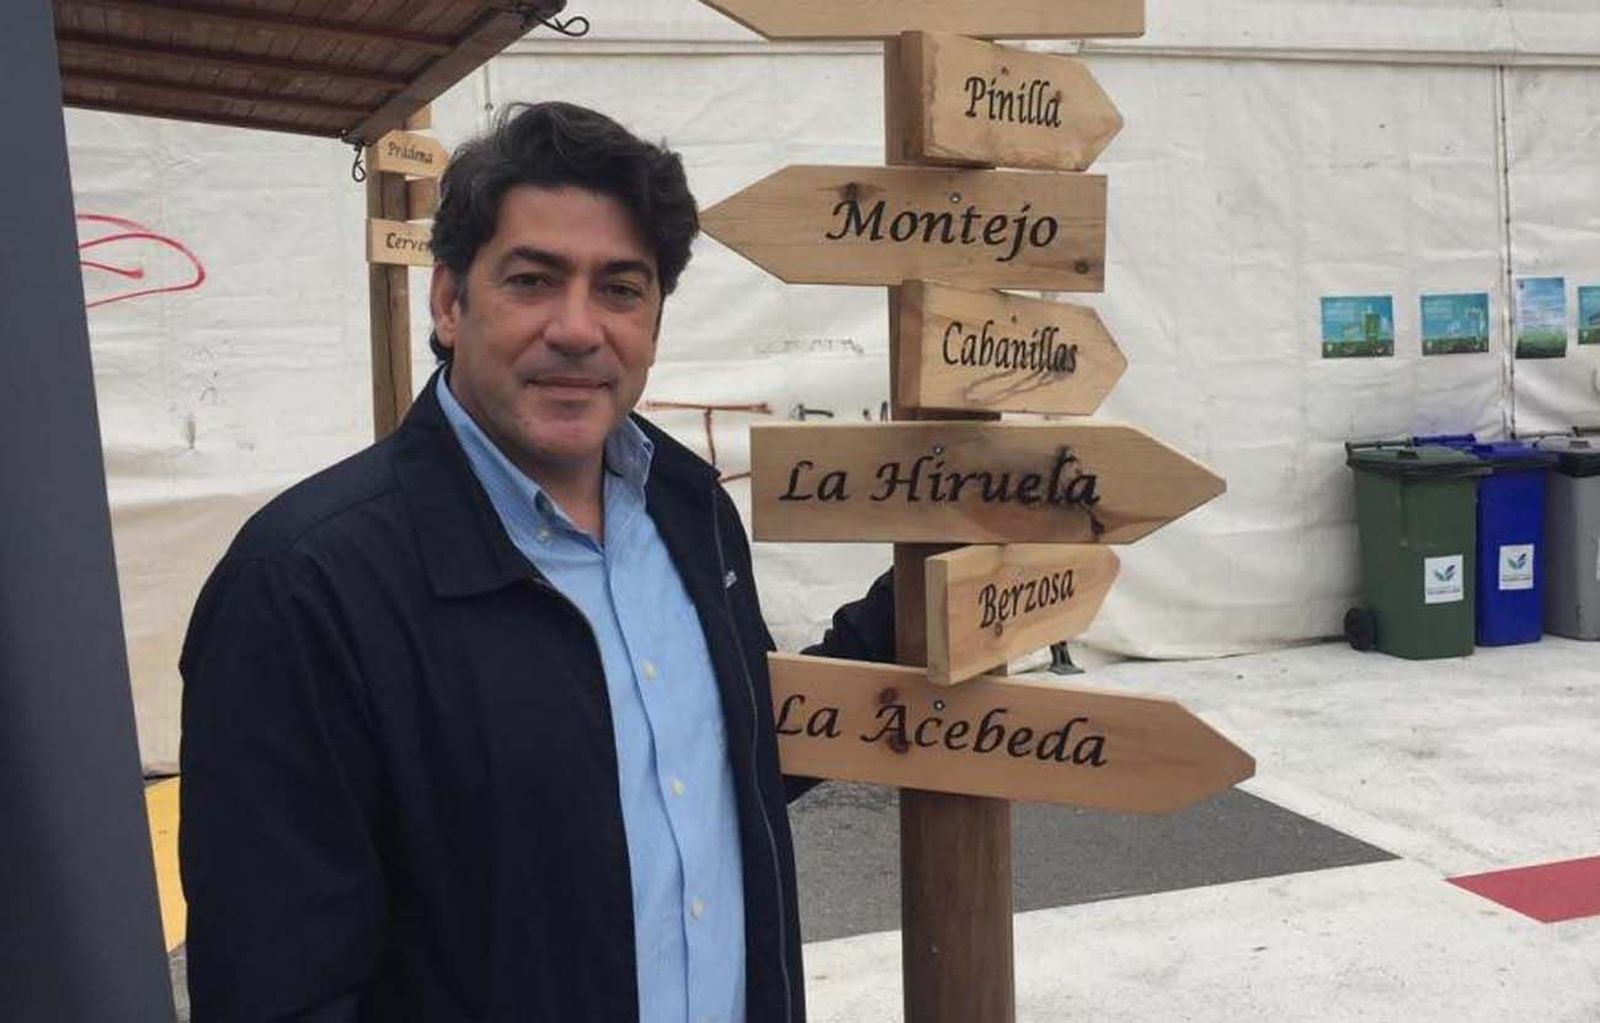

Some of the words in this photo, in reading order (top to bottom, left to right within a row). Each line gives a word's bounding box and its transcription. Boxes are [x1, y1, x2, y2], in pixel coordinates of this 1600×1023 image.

[964, 76, 1062, 128] Pinilla
[386, 232, 431, 251] Cerve
[826, 199, 1059, 261] Montejo
[943, 321, 1079, 374] Cabanillas
[778, 460, 849, 502] La
[870, 450, 1100, 506] Hiruela
[979, 568, 1076, 629] Berzosa
[776, 694, 839, 739] La
[862, 704, 1108, 767] Acebeda
